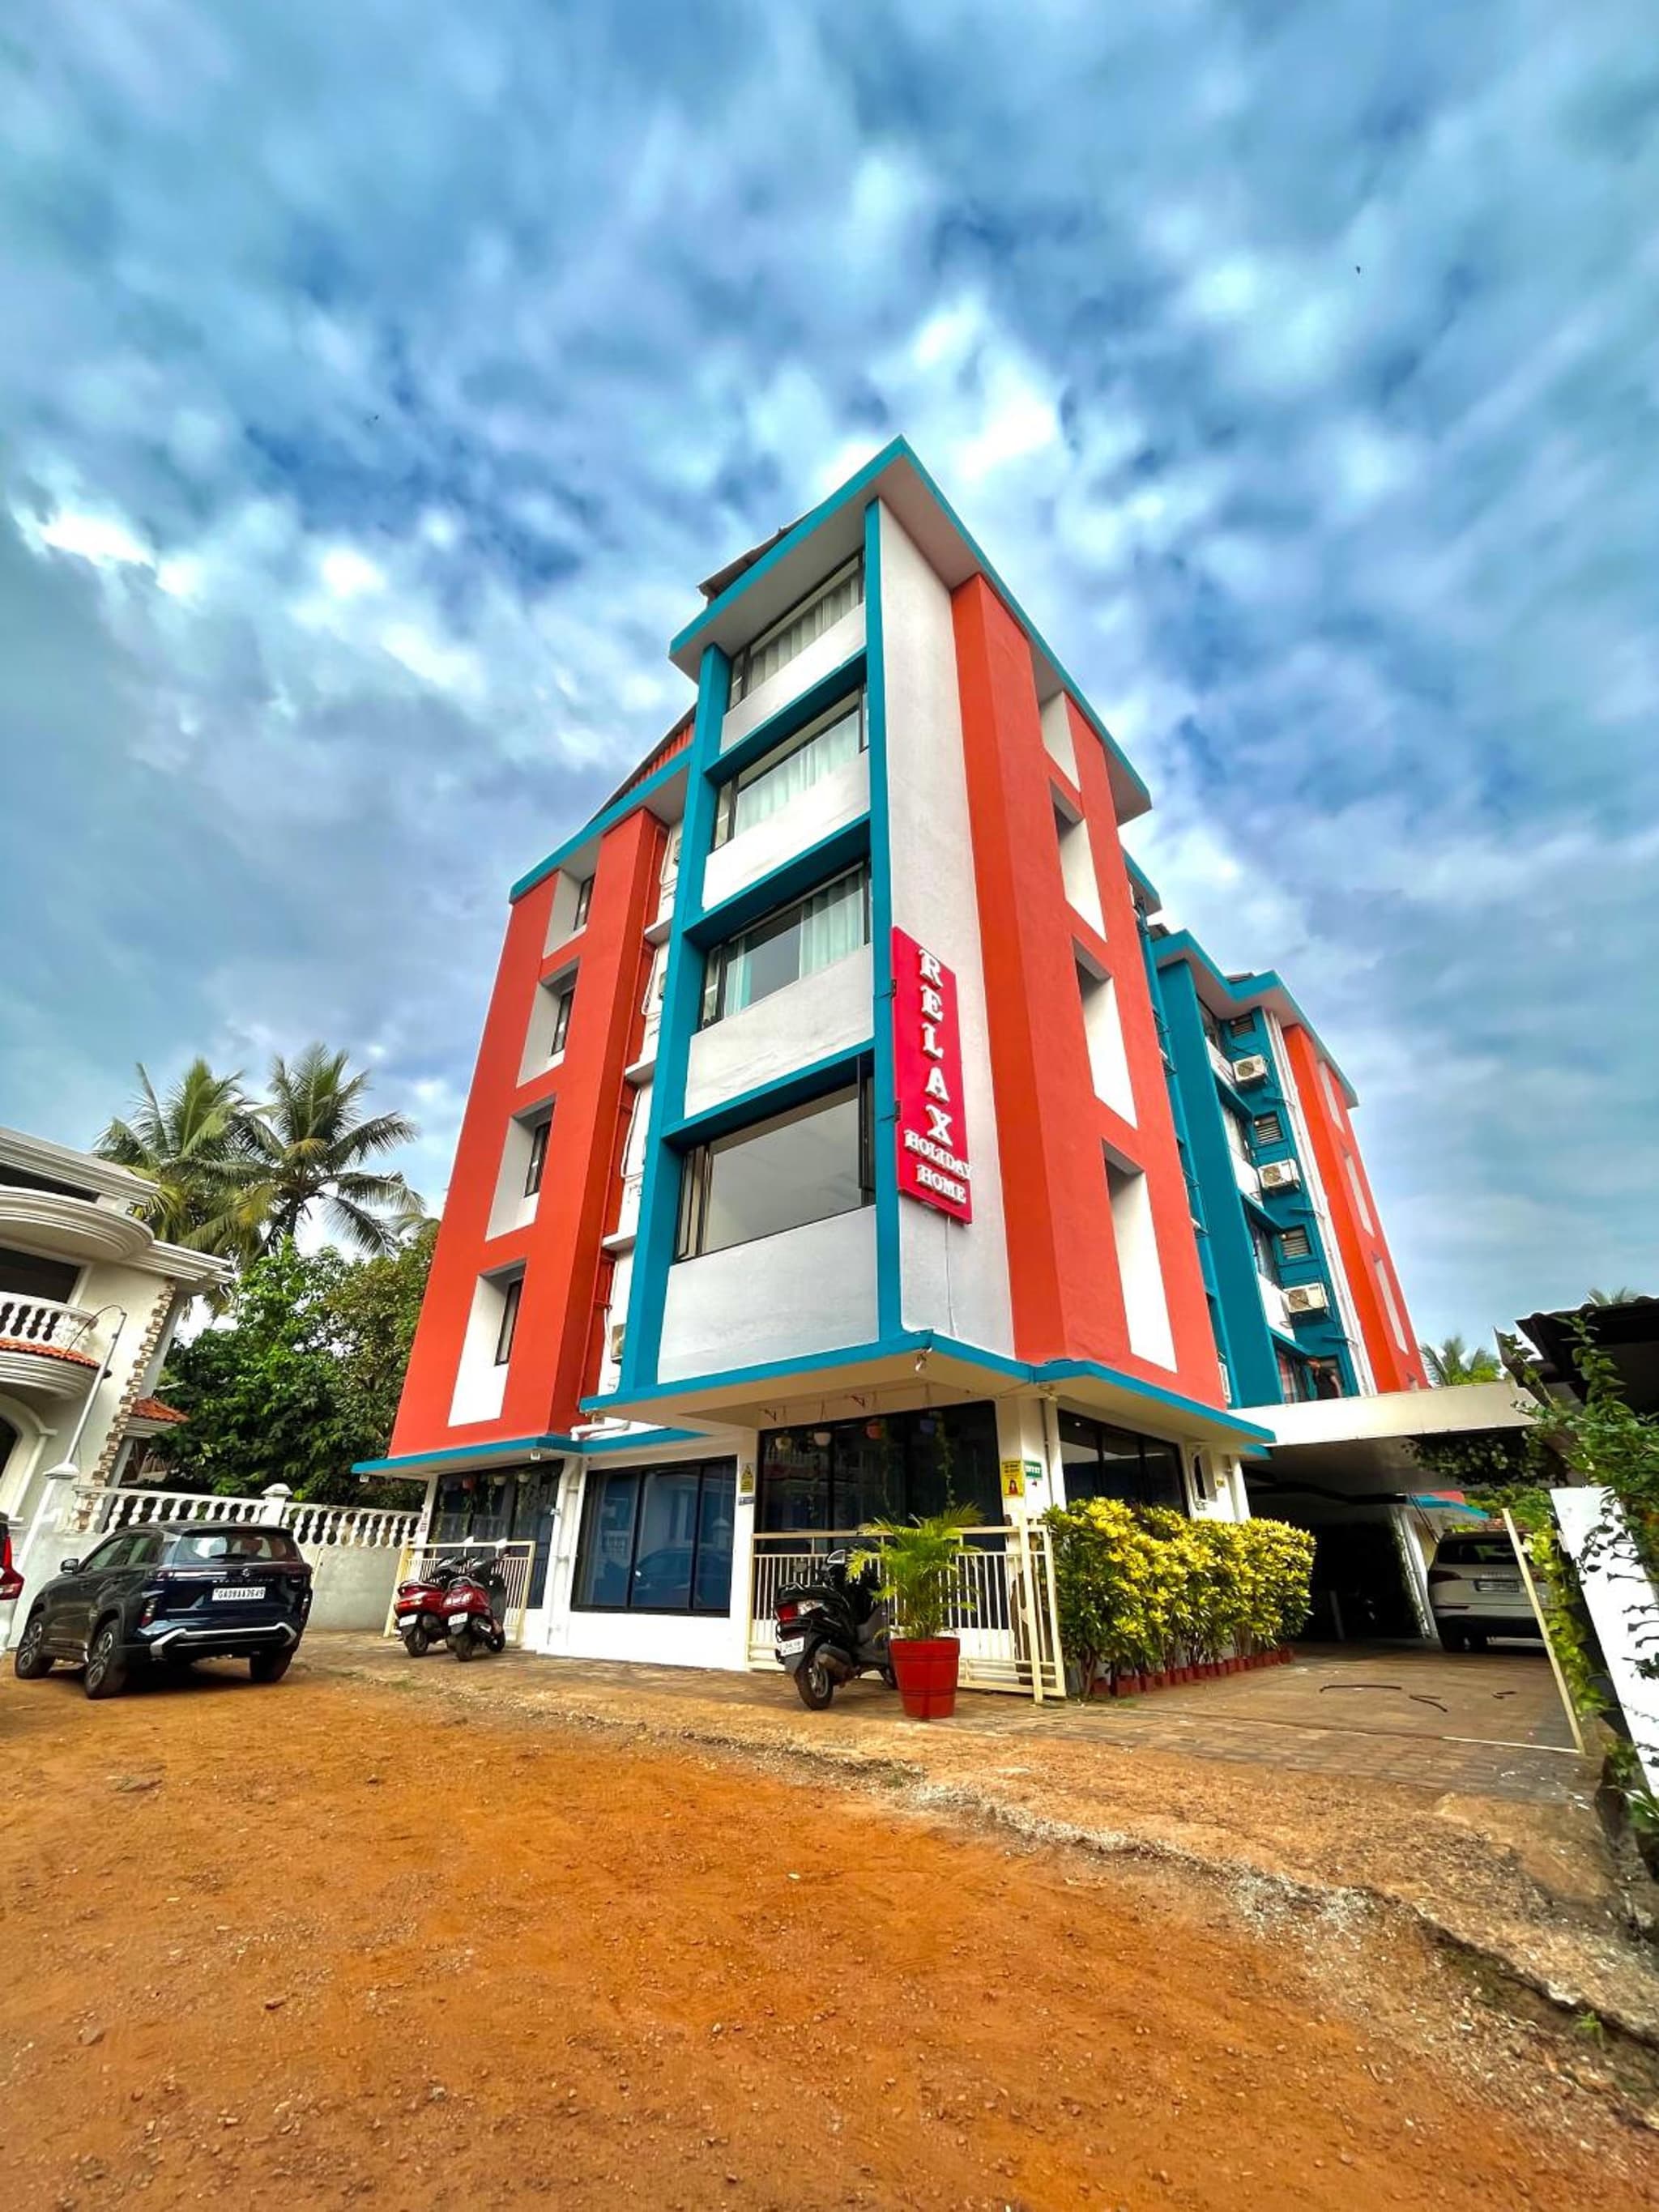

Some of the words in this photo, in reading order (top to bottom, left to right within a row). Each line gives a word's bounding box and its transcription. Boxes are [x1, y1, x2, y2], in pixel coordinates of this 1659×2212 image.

[919, 949, 953, 1146] RELAX
[904, 1129, 973, 1181] HOLIDAY
[916, 1165, 966, 1204] HOME
